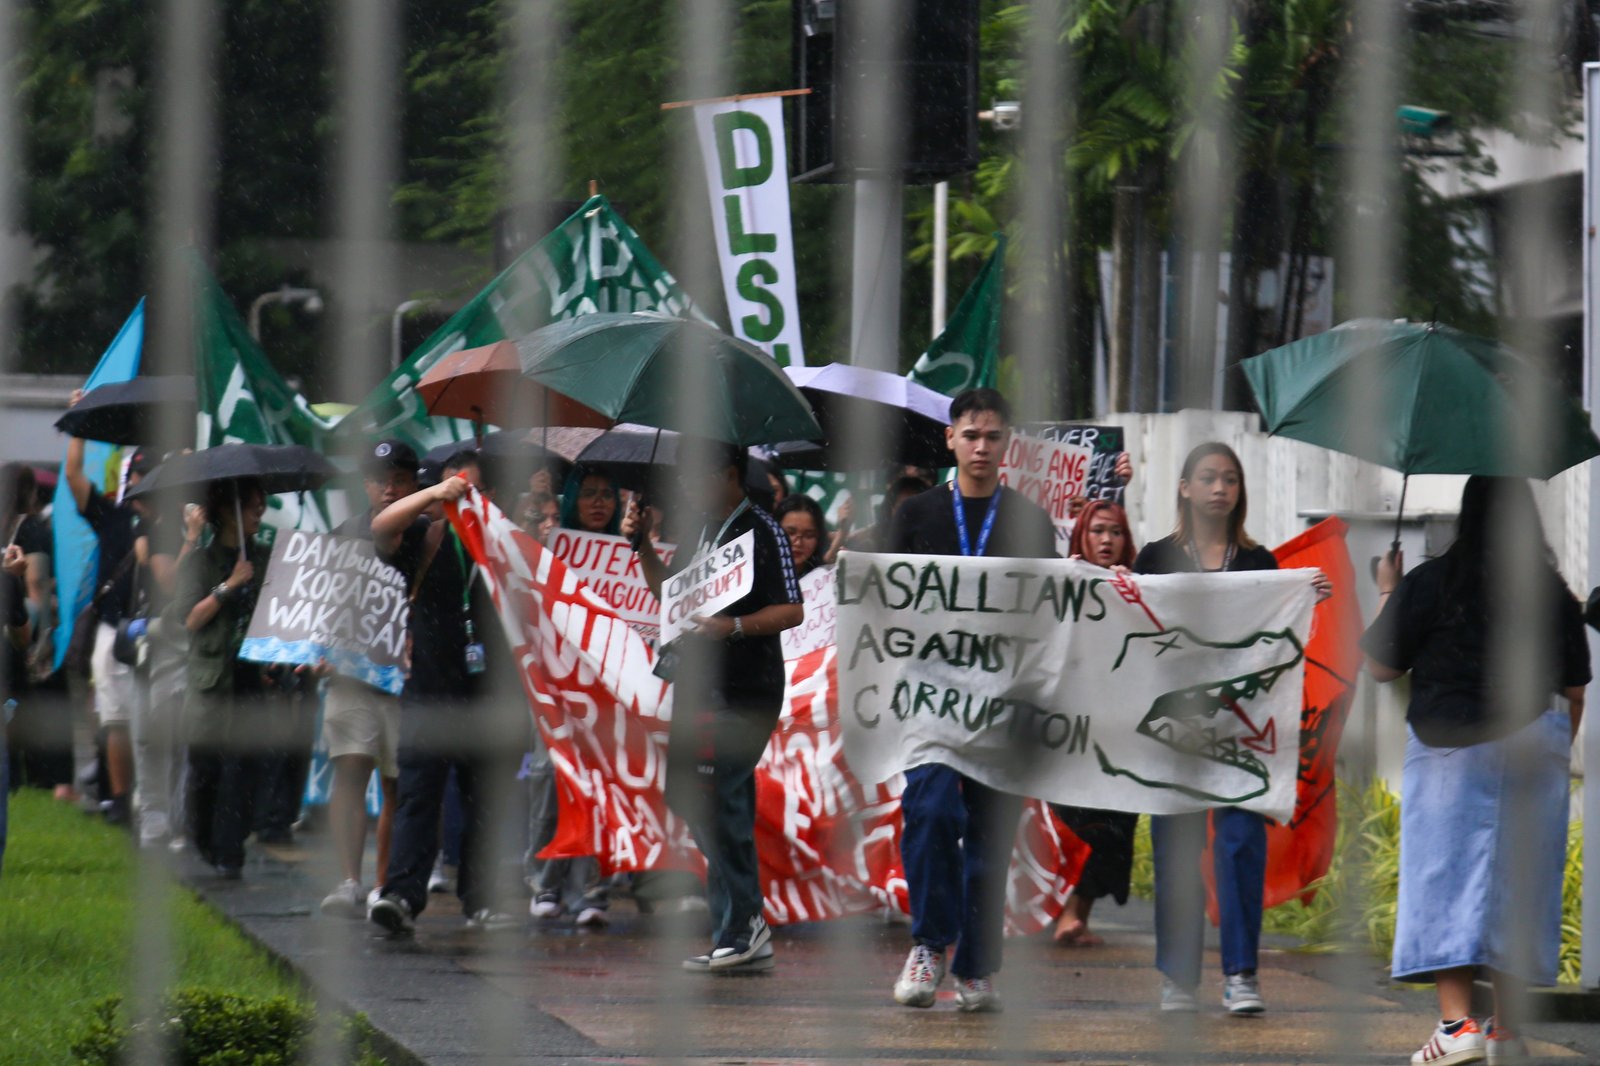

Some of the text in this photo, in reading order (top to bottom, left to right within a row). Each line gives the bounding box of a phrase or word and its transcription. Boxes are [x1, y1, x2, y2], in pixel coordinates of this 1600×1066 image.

[1047, 449, 1087, 482] ANG
[722, 543, 745, 568] SA
[668, 560, 748, 625] CORRUPT
[836, 557, 1107, 623] LASALLIANS
[848, 623, 1040, 679] AGAINST
